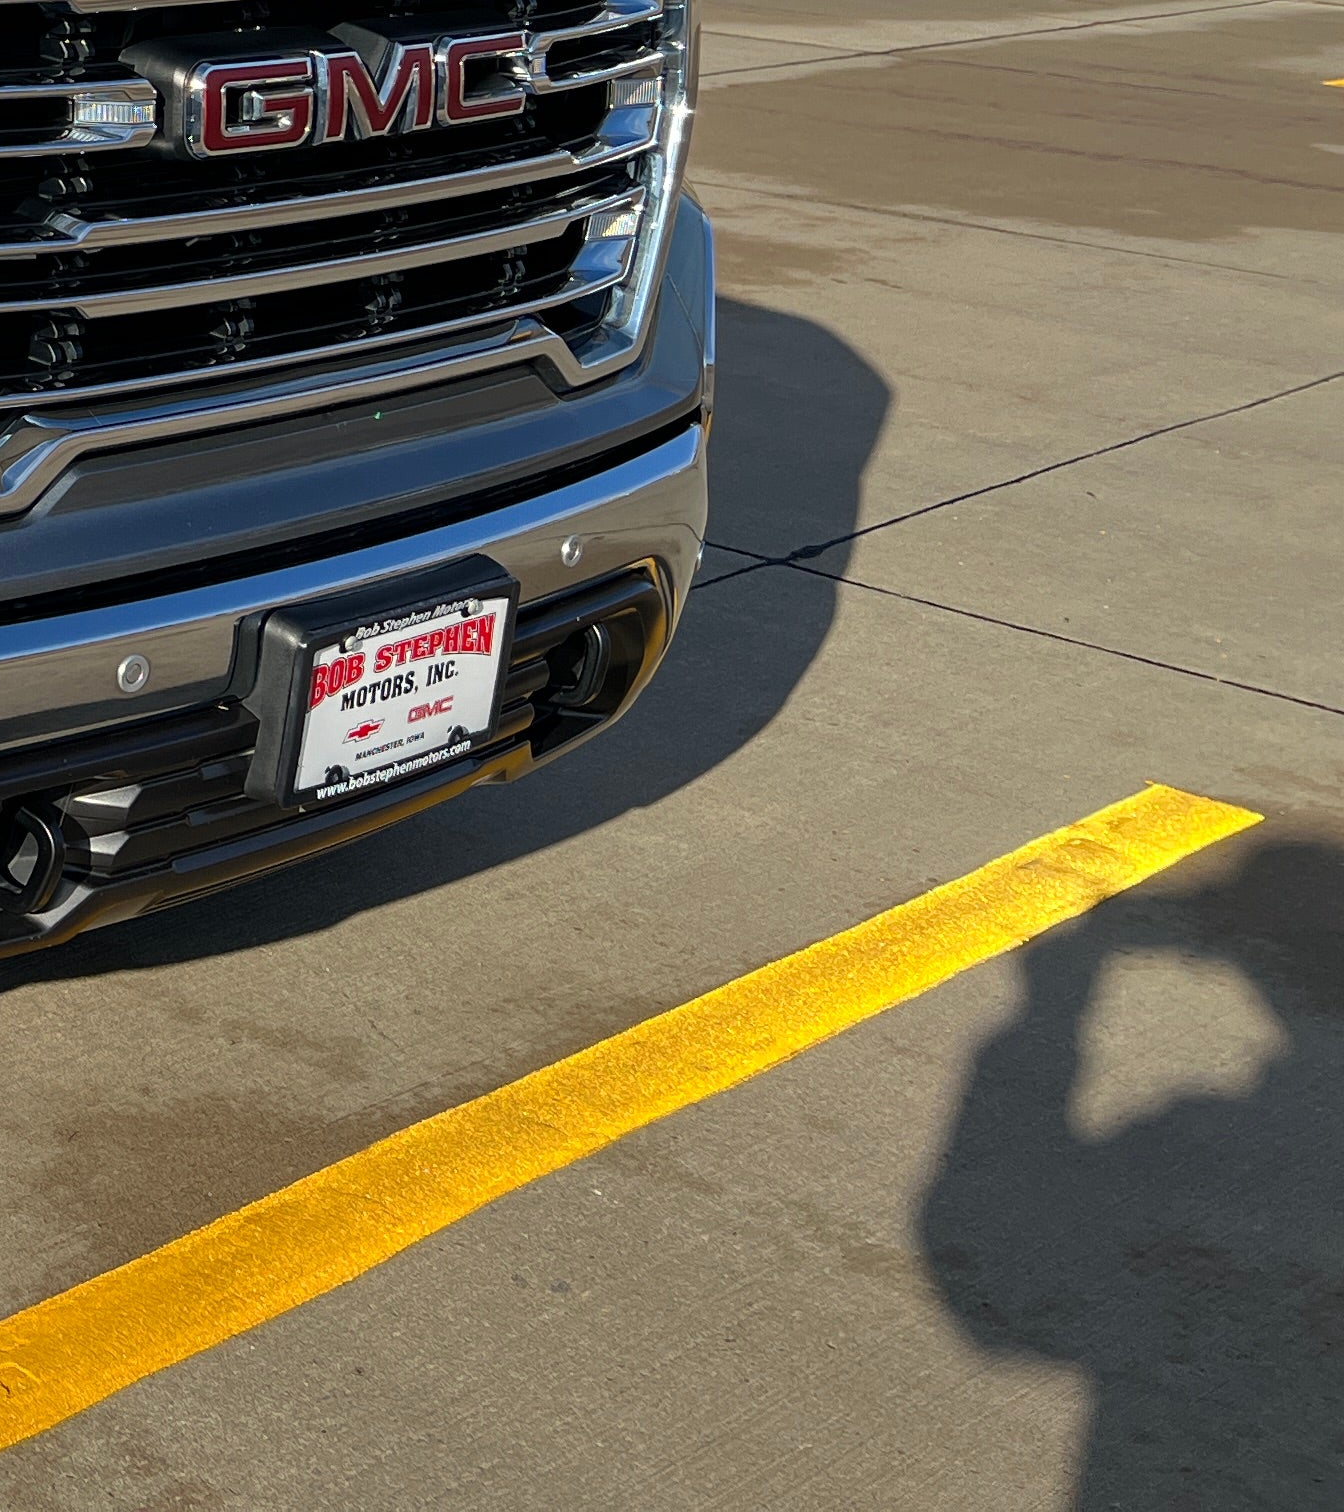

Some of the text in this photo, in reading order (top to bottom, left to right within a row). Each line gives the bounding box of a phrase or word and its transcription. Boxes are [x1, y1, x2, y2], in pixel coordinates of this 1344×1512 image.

[188, 30, 527, 160] GMC
[355, 624, 380, 640] Bob
[379, 609, 431, 635] Stephen
[307, 612, 497, 711] BOB STEPHEN
[340, 660, 459, 712] MOTORS, INC.
[406, 696, 455, 724] GMC
[316, 738, 472, 800] www.bobstephenmotors.com
